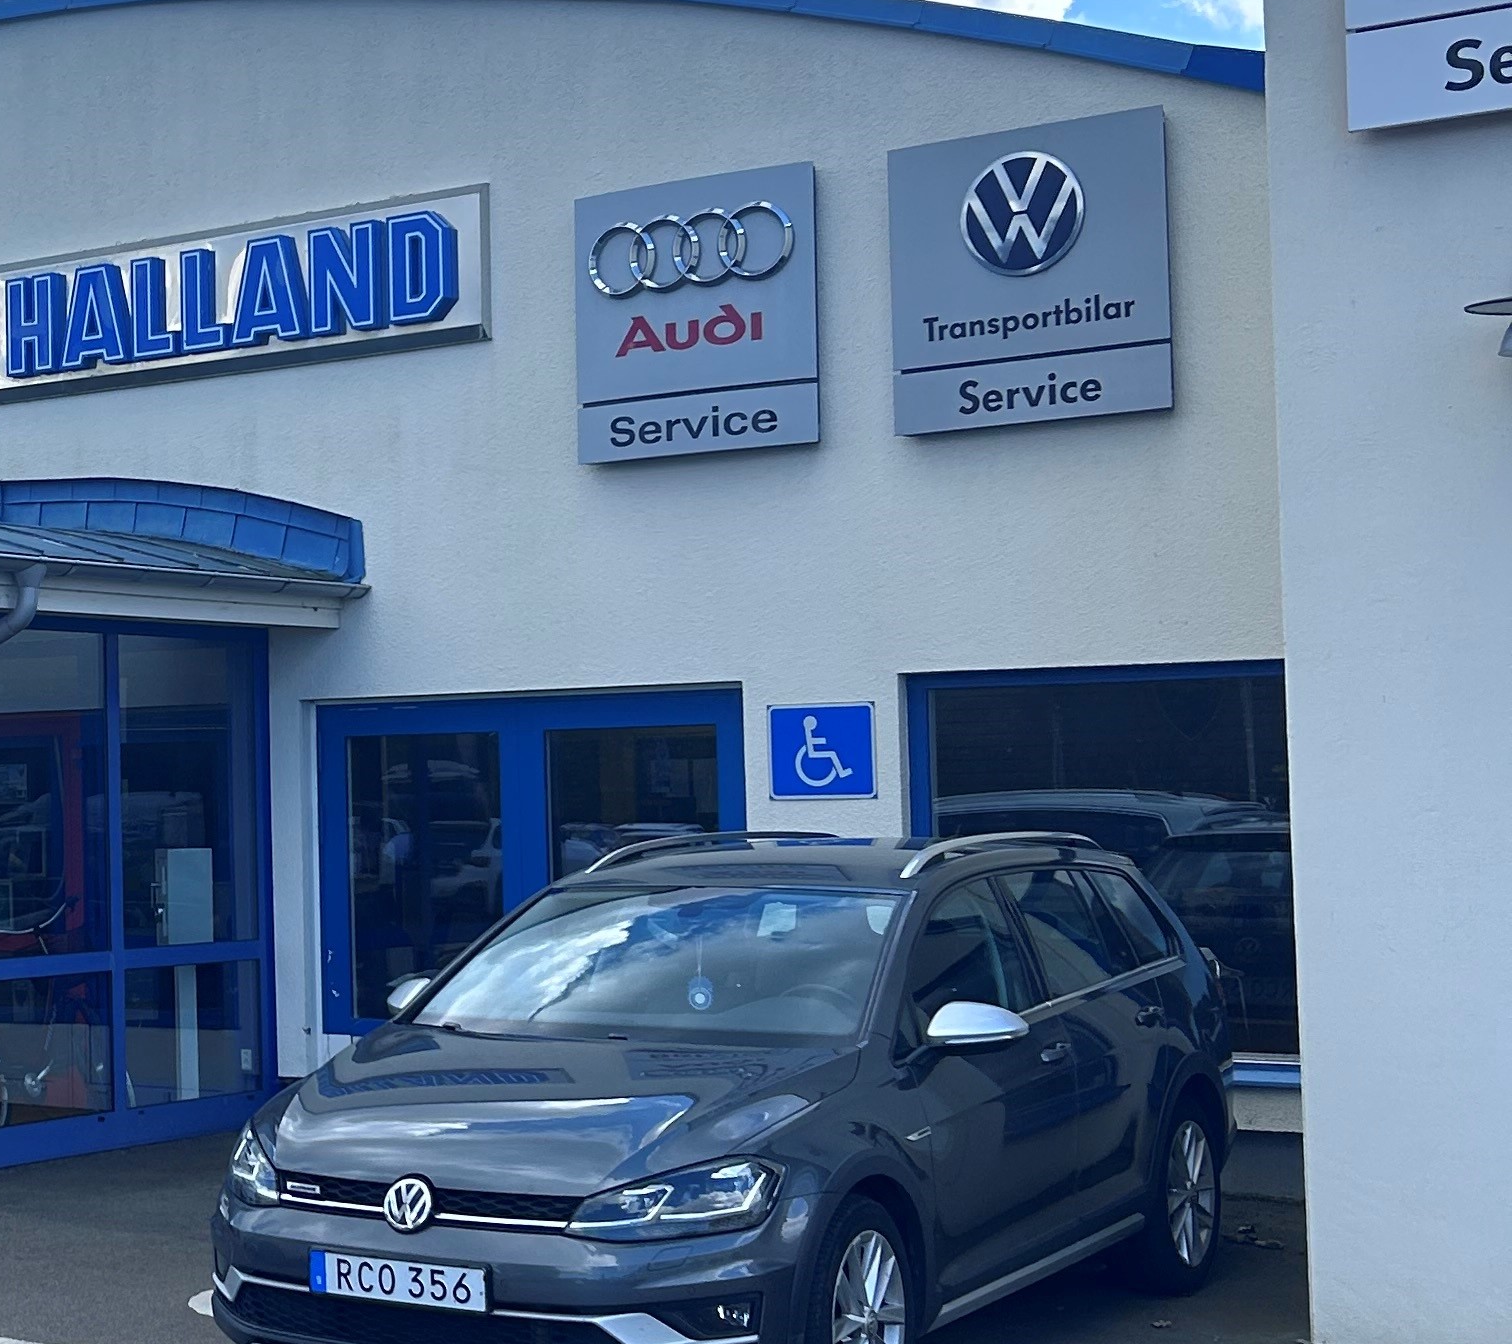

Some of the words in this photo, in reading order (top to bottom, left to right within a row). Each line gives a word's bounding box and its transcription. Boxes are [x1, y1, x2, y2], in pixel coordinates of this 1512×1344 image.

[6, 210, 458, 378] HALLAND
[615, 304, 764, 358] Audi
[923, 294, 1135, 343] Transportbilar
[958, 373, 1103, 416] Service
[609, 406, 779, 448] Service
[337, 1258, 396, 1295] RCO
[408, 1266, 471, 1304] 356
